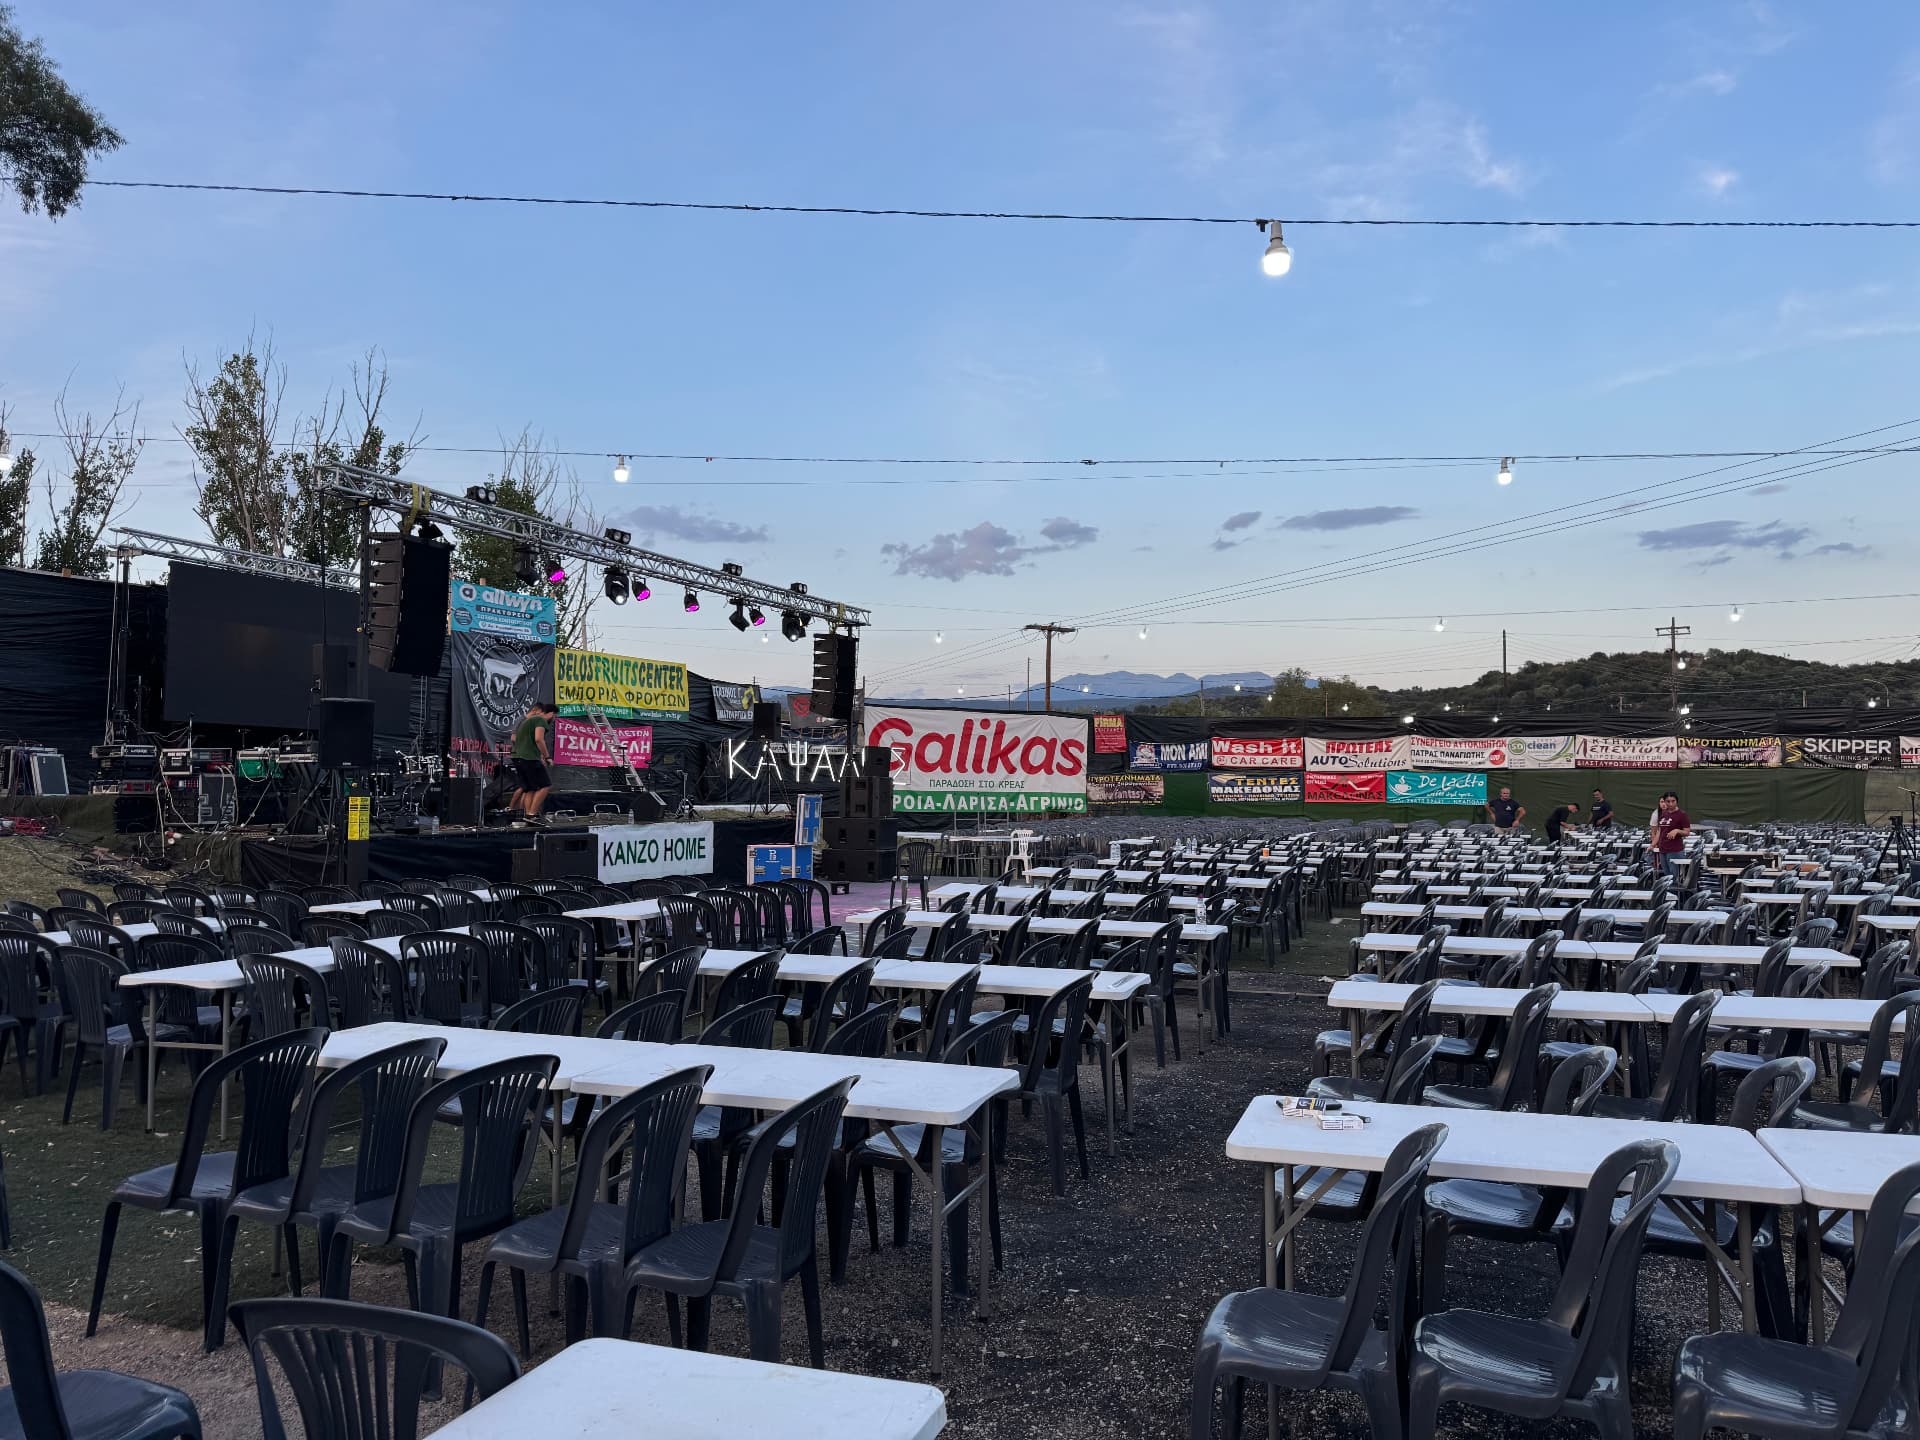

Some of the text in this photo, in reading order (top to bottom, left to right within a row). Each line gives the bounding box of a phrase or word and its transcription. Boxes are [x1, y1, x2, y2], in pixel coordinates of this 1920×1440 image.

[482, 588, 543, 614] allwyn
[480, 606, 531, 619] ΠΡΑΚΤΟΡΕΙΟ
[558, 685, 687, 708] ΕΜΠΟΡΙΑ ΦΡΟΥΤΩΝ
[558, 722, 602, 736] ΓΡΑΦΕΙ
[868, 717, 1085, 776] Galikas
[1213, 740, 1273, 754] Wash
[1325, 740, 1393, 754] ΠΡΩΤΕΑΣ
[1410, 737, 1451, 748] ΣΥΝΕΡΓΕΙΟ
[1453, 740, 1507, 749] ΑΥΤΟΚΙΝΗΤΩΝ
[1527, 741, 1556, 749] clean
[1678, 737, 1781, 747] ΠΥΡΟΤΕΧΝΗΜΑΤΑ
[1804, 738, 1892, 754] SKIPPER
[1161, 744, 1186, 761] MON
[1440, 751, 1486, 759] ΠΑΝΑΓΙΩΤΗΣ
[1230, 756, 1297, 765] CAR CARE
[929, 779, 1025, 789] ΠΑΡΑΔΟΣΗ ΣΤΟ ΚΡΕΑΣ
[1237, 778, 1299, 786] ΤΕΝΤΕΣ
[1417, 775, 1437, 789] De
[1211, 785, 1301, 794] ΜΑΚΕΔΟΝΑΣ
[892, 793, 1084, 811] ΡΟΙΑ-ΛΑΡΙΣΑ-ΑΓΡΙΝΙΟ
